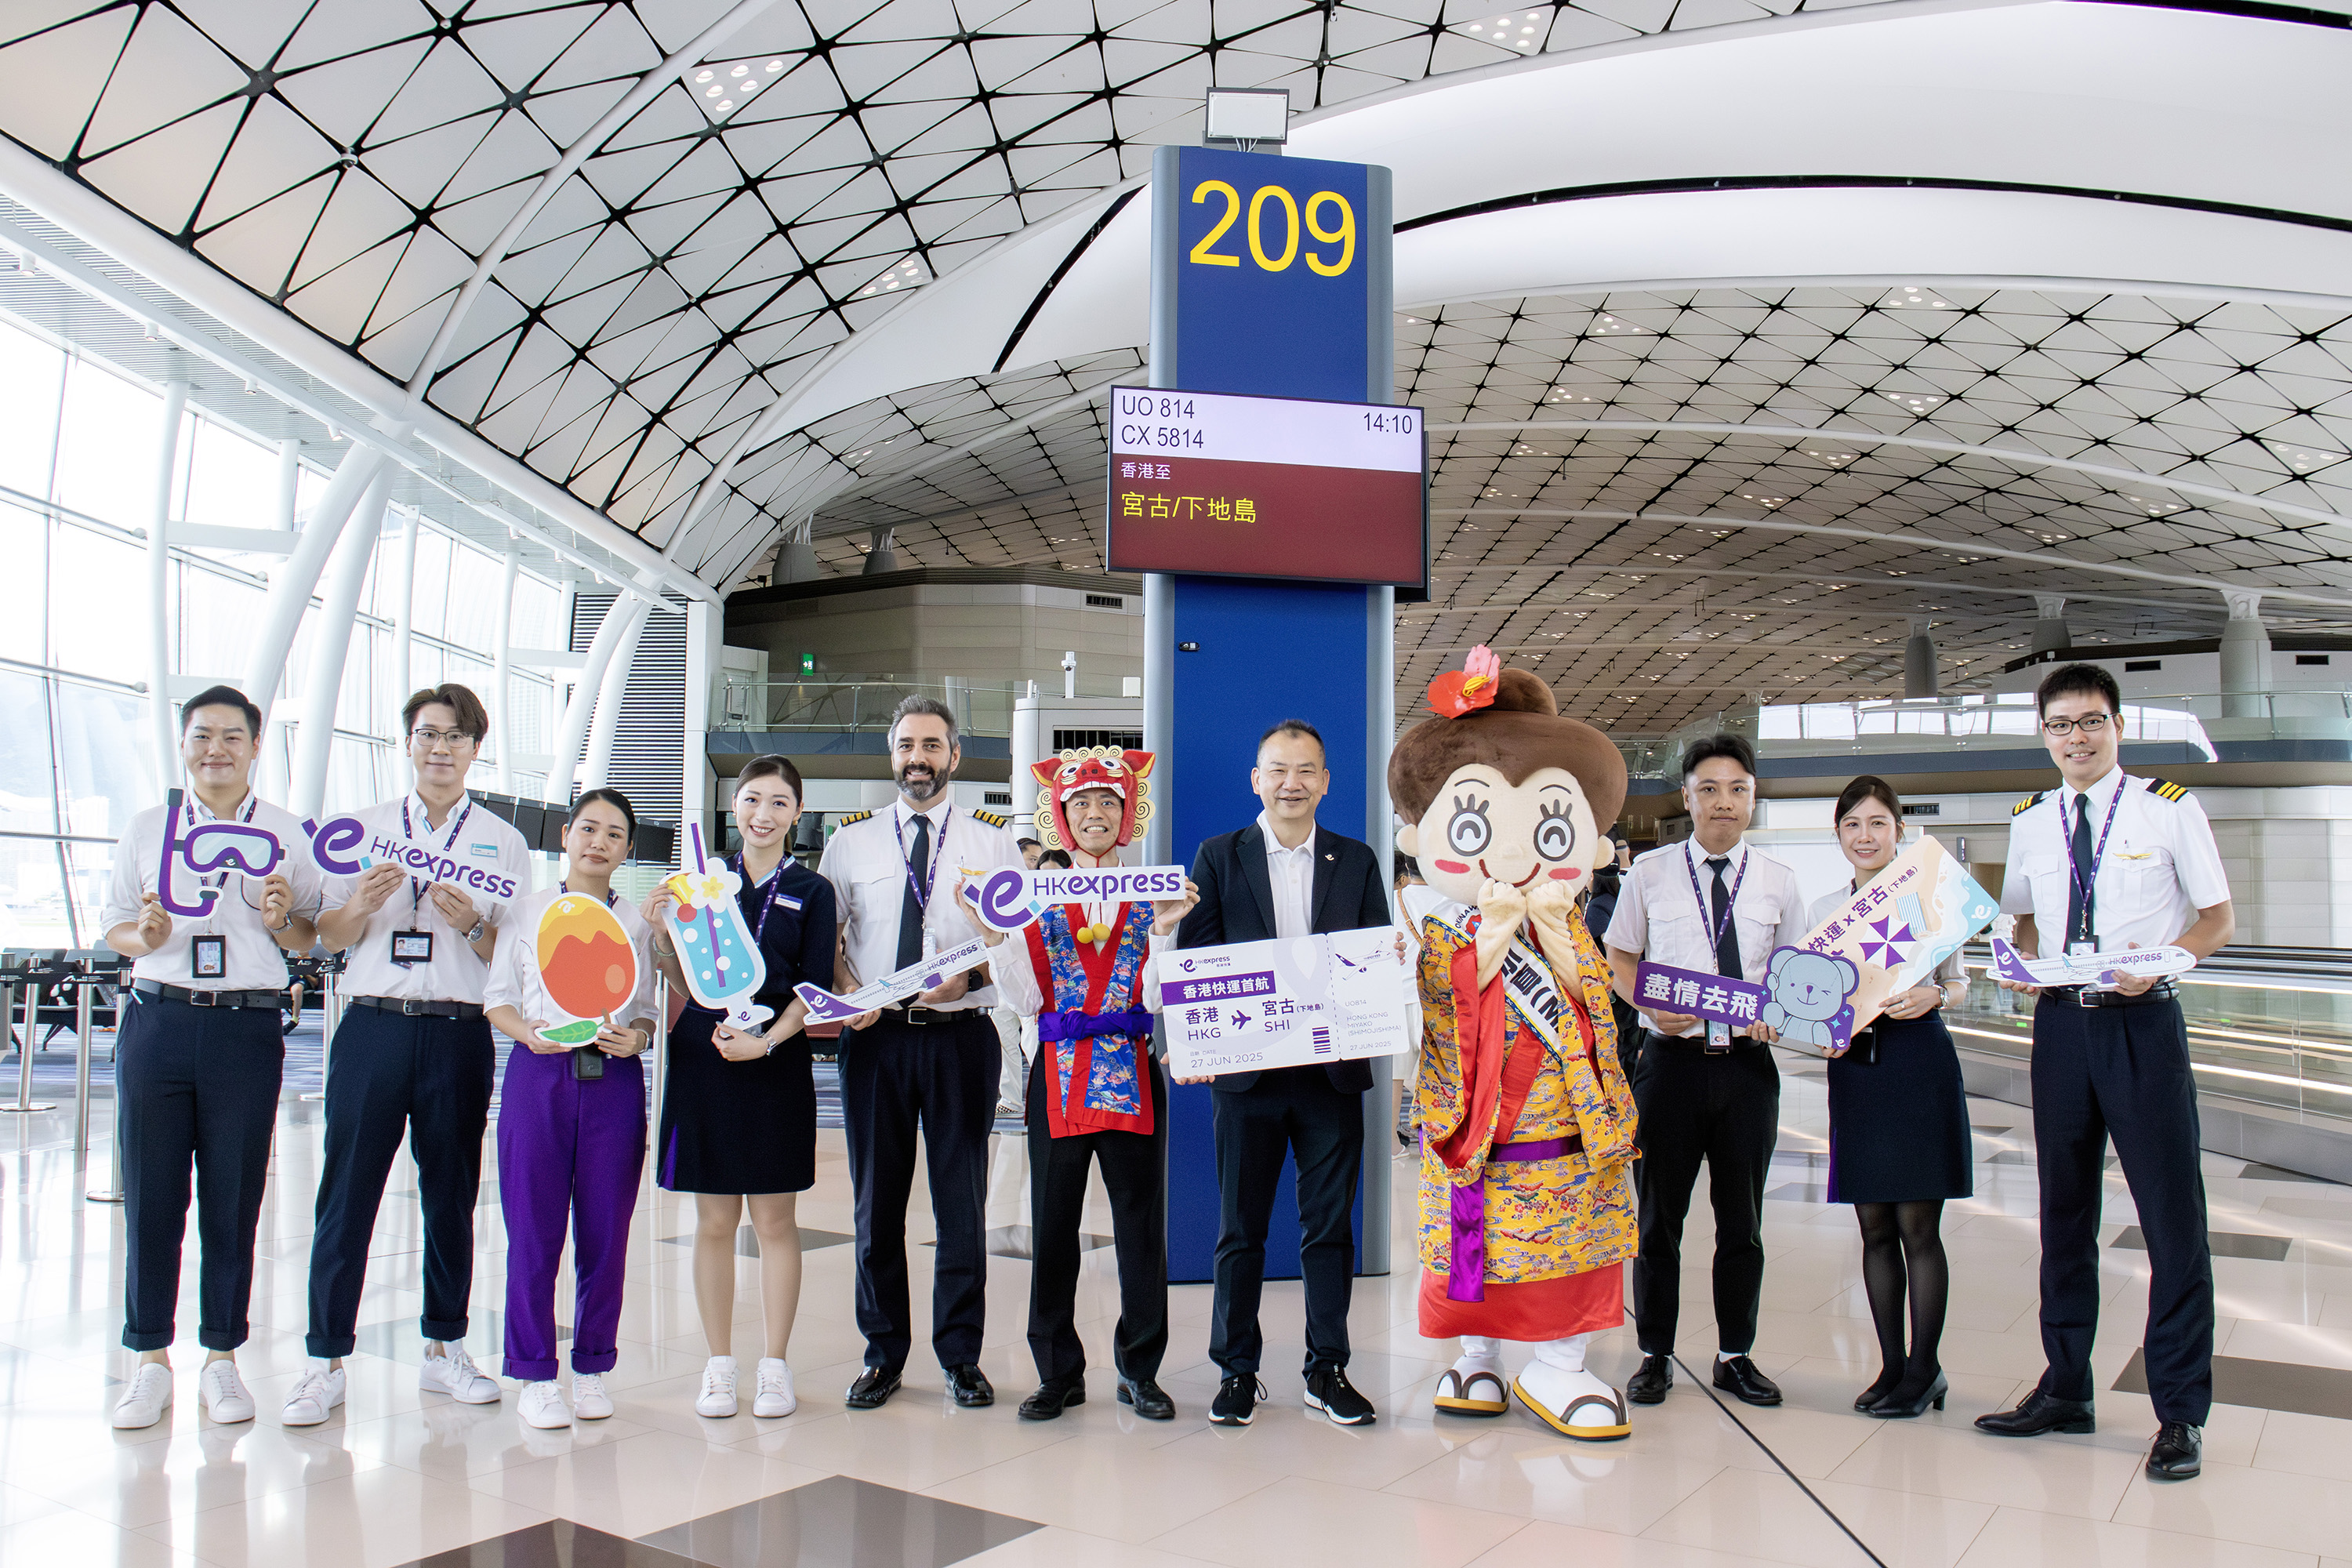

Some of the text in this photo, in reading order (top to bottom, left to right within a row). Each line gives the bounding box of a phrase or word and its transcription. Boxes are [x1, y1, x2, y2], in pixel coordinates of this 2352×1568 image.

[1189, 180, 1356, 277] 209
[1122, 395, 1195, 419] UO 814
[1363, 412, 1413, 434] 14:10
[1121, 424, 1204, 448] CX 5814
[1120, 462, 1171, 480] 香港至
[1121, 491, 1257, 524] 宮古/下地島
[370, 836, 517, 898] HKexpress
[1033, 873, 1181, 901] HKexpress
[1455, 906, 1479, 928] OKINAW
[1801, 920, 1846, 952] 快運
[927, 944, 978, 971] HKexpress
[2109, 952, 2162, 965] HKexpress
[1182, 977, 1270, 1000] 香港快運首航
[1642, 973, 1759, 1021] 盡情去飛
[1185, 1007, 1220, 1025] 香港
[1265, 1019, 1290, 1033] SHI
[1188, 1027, 1221, 1041] HKG
[1191, 1051, 1264, 1069] 27 JUN 2025
